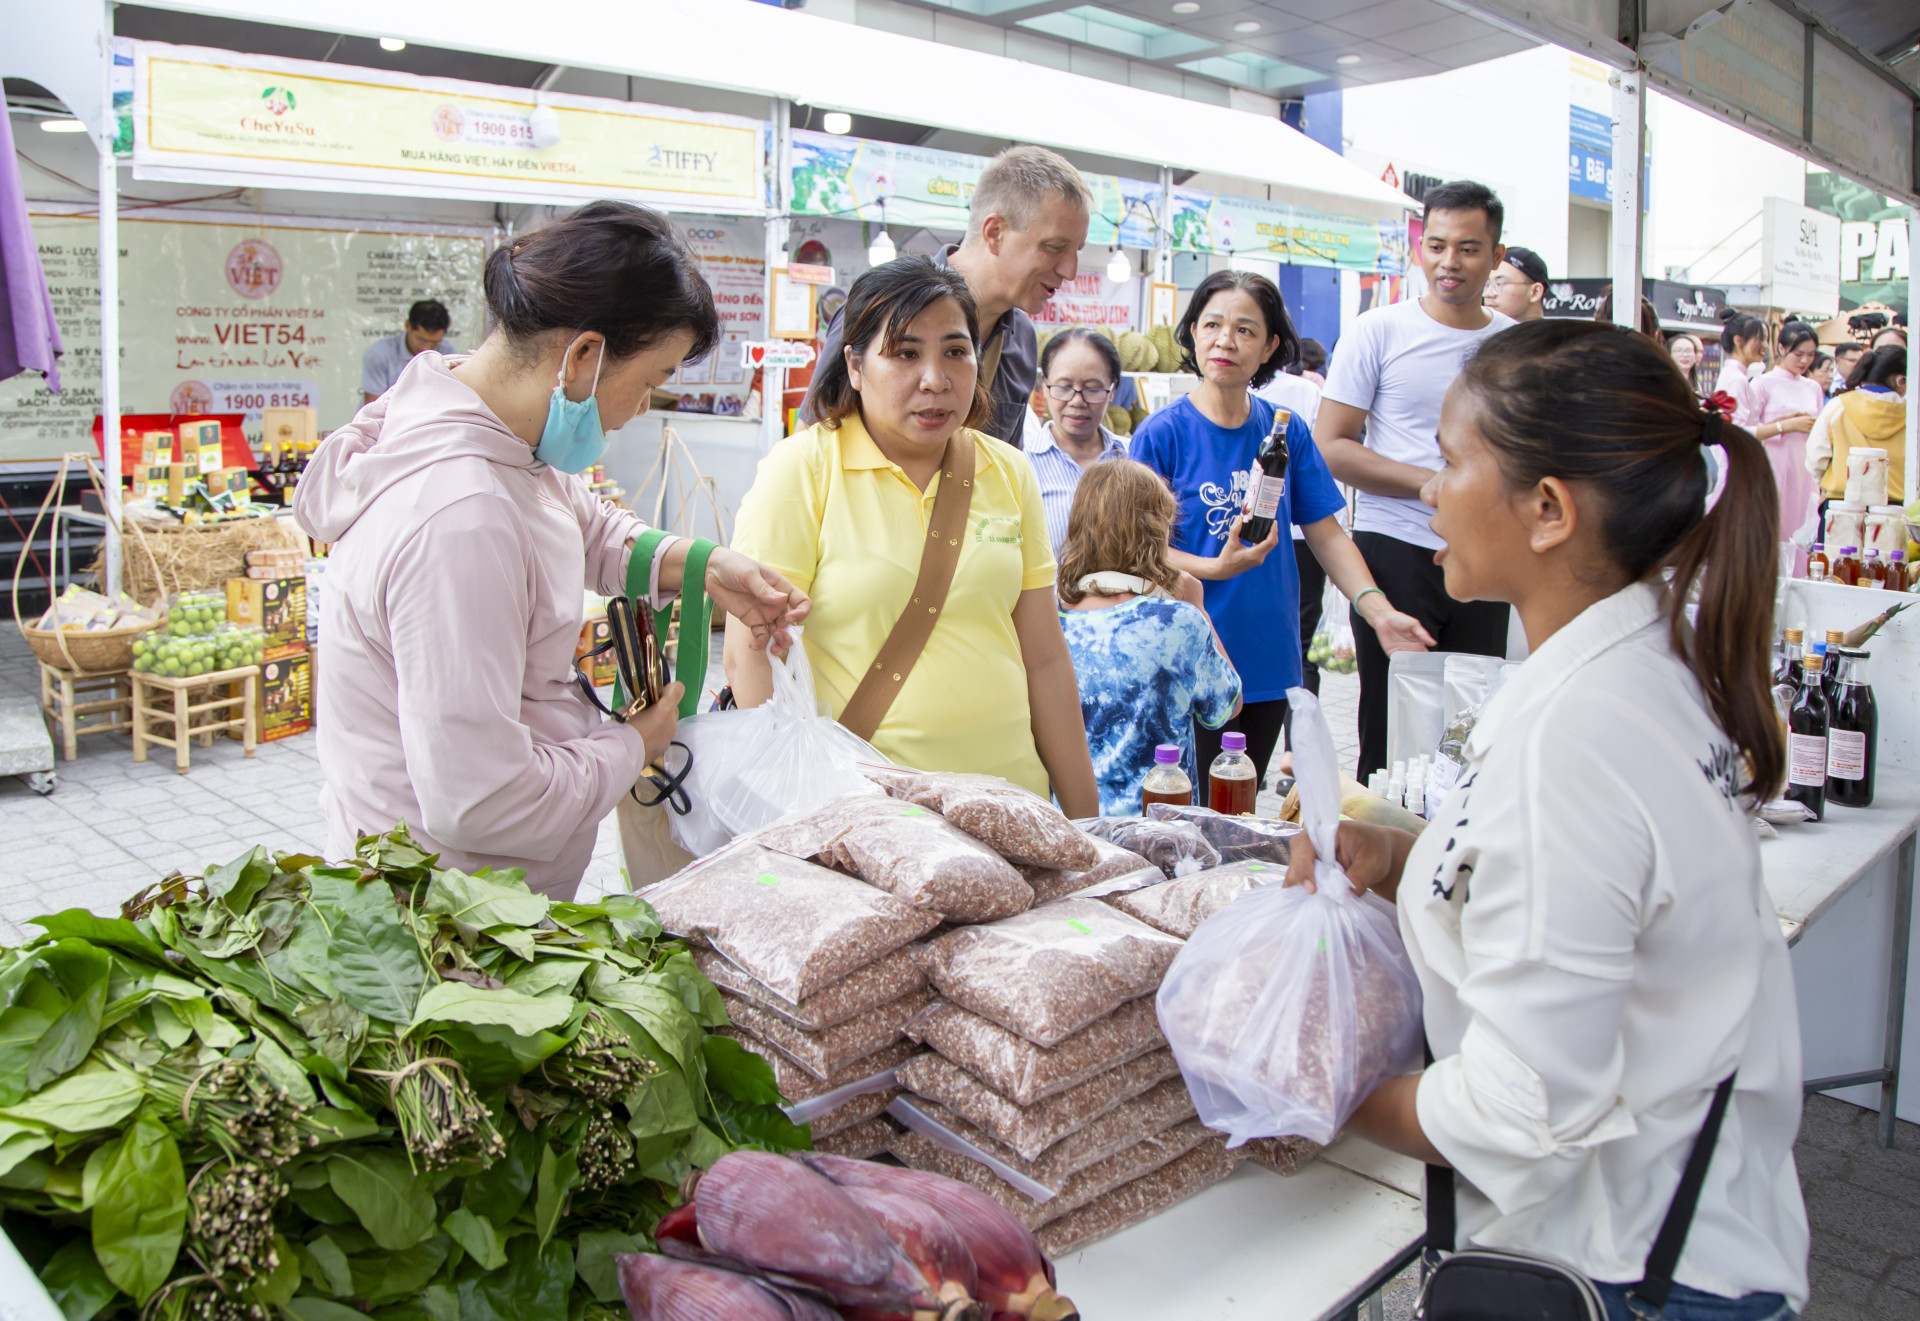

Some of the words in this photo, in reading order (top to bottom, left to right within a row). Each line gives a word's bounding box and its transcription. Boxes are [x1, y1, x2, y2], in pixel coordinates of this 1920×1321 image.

[240, 117, 315, 136] CheYuSu
[474, 121, 505, 136] 1900
[510, 125, 534, 139] 815
[401, 149, 426, 160] MUA
[429, 150, 461, 164] HÀNG
[517, 158, 539, 171] ĐẾN
[662, 149, 718, 172] TIFFY
[928, 176, 960, 197] CÔNG
[687, 228, 725, 240] OCOP
[1841, 217, 1909, 283] PA
[713, 293, 740, 305] IÊNG
[743, 291, 764, 305] ĐẾN
[1569, 294, 1604, 312] Rot
[215, 307, 229, 318] TY
[312, 308, 325, 318] 54
[739, 311, 761, 321] SƠN
[224, 394, 265, 410] 1900
[270, 393, 310, 408] 8154
[1231, 470, 1251, 492] 18
